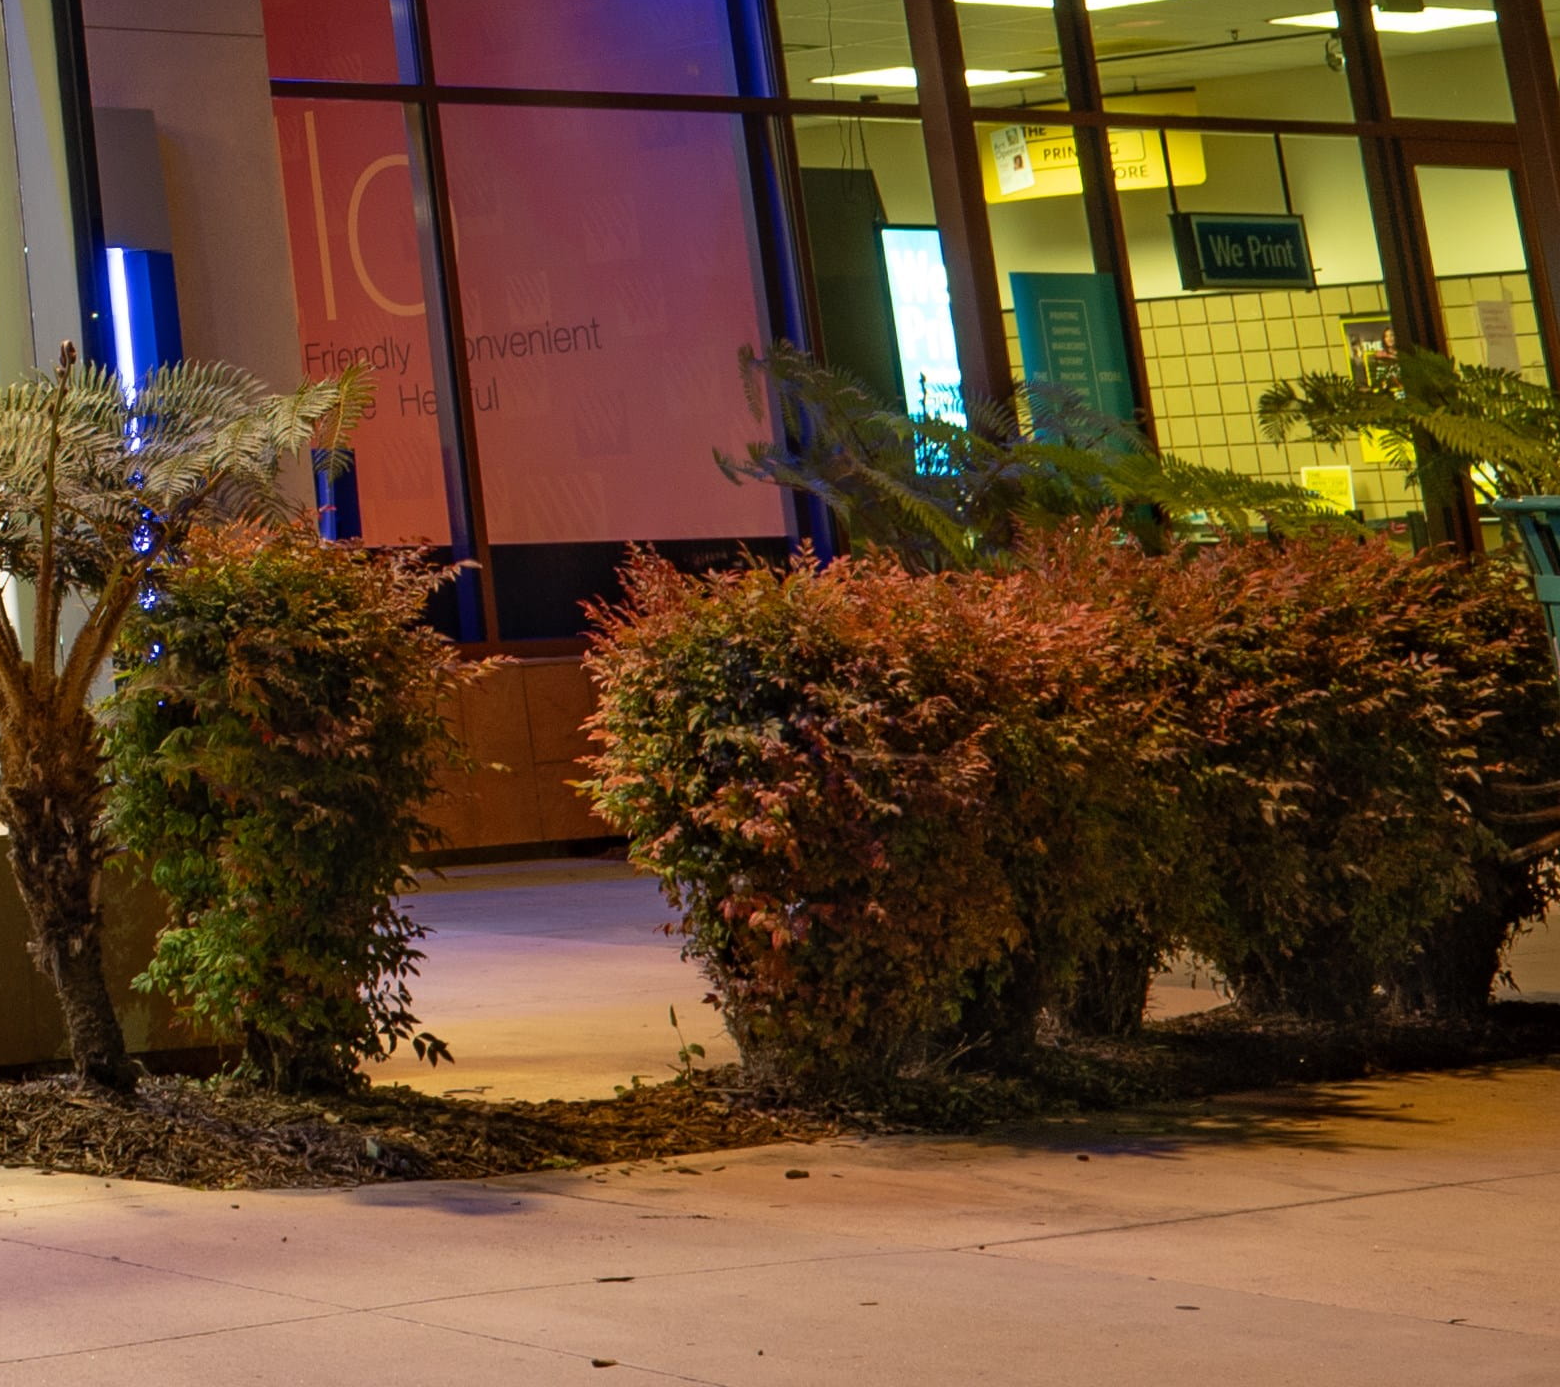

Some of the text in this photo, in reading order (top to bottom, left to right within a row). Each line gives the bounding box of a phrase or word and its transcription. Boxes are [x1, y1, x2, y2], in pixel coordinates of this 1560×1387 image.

[1208, 234, 1297, 268] We Print
[463, 318, 603, 363] onvenient
